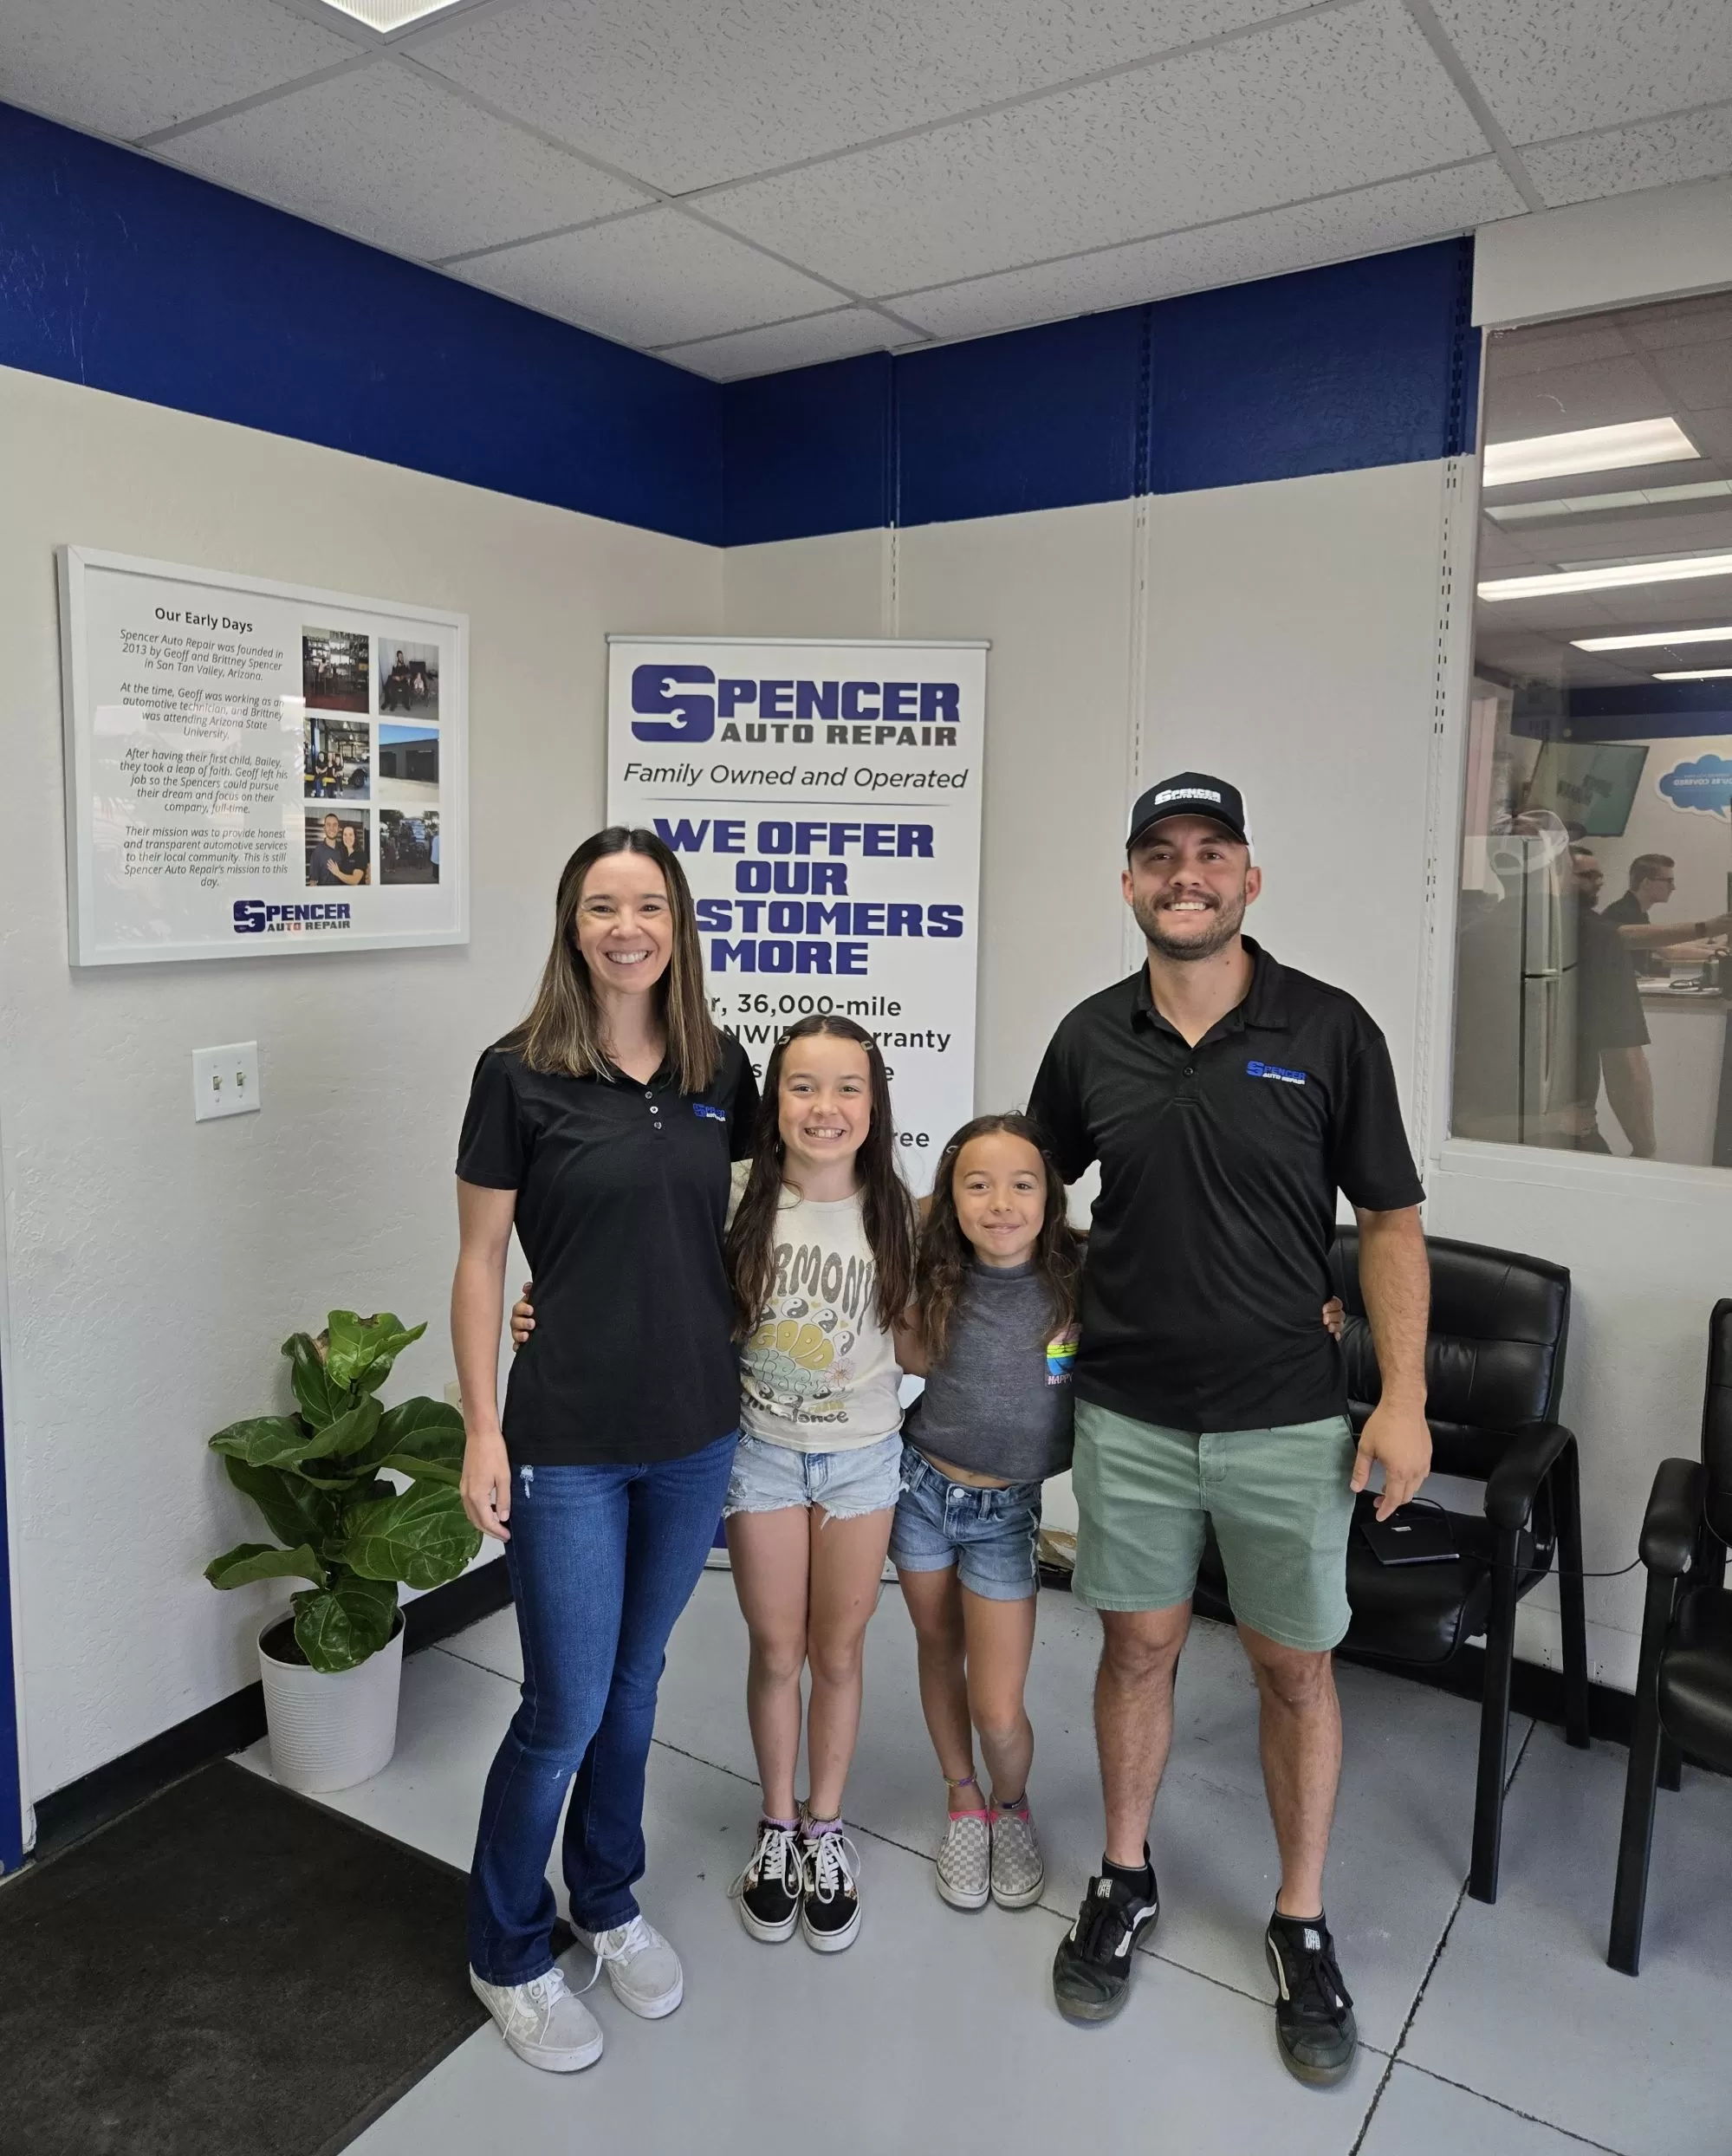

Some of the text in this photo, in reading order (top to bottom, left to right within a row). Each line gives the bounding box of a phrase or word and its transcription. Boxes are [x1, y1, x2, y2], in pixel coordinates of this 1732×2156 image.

[155, 607, 253, 633] Our Early Days
[120, 629, 159, 643] Spencer
[161, 634, 183, 646] Auto
[186, 638, 215, 651] Repair
[237, 645, 273, 658] founded
[122, 643, 282, 672] 2013 by Geoff and Brittney Spencer
[145, 659, 263, 681] in San Tan Valley, Arizona.
[120, 683, 131, 692] At
[134, 684, 149, 694] the
[152, 686, 174, 698] time,
[178, 688, 204, 701] Geoff
[224, 694, 259, 707] working
[632, 664, 960, 743] SPENCER
[123, 697, 284, 721] automotive technician, and Brittney
[142, 711, 268, 730] was attending Arizona State
[184, 727, 230, 741] University.
[720, 723, 957, 746] AUTO REPAIR
[126, 749, 282, 769] After having their first child, Bailey,
[120, 762, 140, 773] they
[143, 763, 164, 772] took
[176, 763, 195, 776] leap
[198, 765, 207, 777] of
[209, 766, 232, 777] faith.
[236, 767, 260, 781] Geoff
[261, 770, 274, 781] left
[276, 770, 288, 779] his
[624, 763, 969, 791] Family Owned and Operated
[130, 775, 146, 787] job
[163, 776, 178, 786] the
[180, 776, 221, 790] Spencers
[224, 779, 246, 789] could
[250, 781, 279, 792] pursue
[137, 788, 159, 798] their
[162, 789, 192, 799] dream
[196, 790, 212, 800] and
[215, 791, 238, 802] focus
[255, 791, 274, 802] their
[165, 802, 250, 815] company, full-time.
[126, 826, 285, 839] Their mission was to provide honest
[652, 818, 935, 858] WE OFFER
[124, 840, 288, 851] and transparent automotive services
[126, 852, 286, 864] to their local community. This is still
[125, 865, 163, 876] Spencer
[165, 865, 186, 874] Auto
[189, 865, 224, 876] Repair's
[227, 865, 260, 873] mission
[274, 865, 288, 873] this
[736, 860, 848, 896] OUR
[200, 878, 219, 887] day.
[233, 899, 351, 933] SPENCER
[267, 920, 351, 932] AUTO REPAIR
[695, 899, 963, 938] STOMERS
[710, 938, 868, 976] MORE
[737, 993, 902, 1016] 36,000-mile
[873, 1029, 952, 1053] rranty
[774, 1243, 875, 1335] RMONY
[1047, 1373, 1074, 1386] HAPPY
